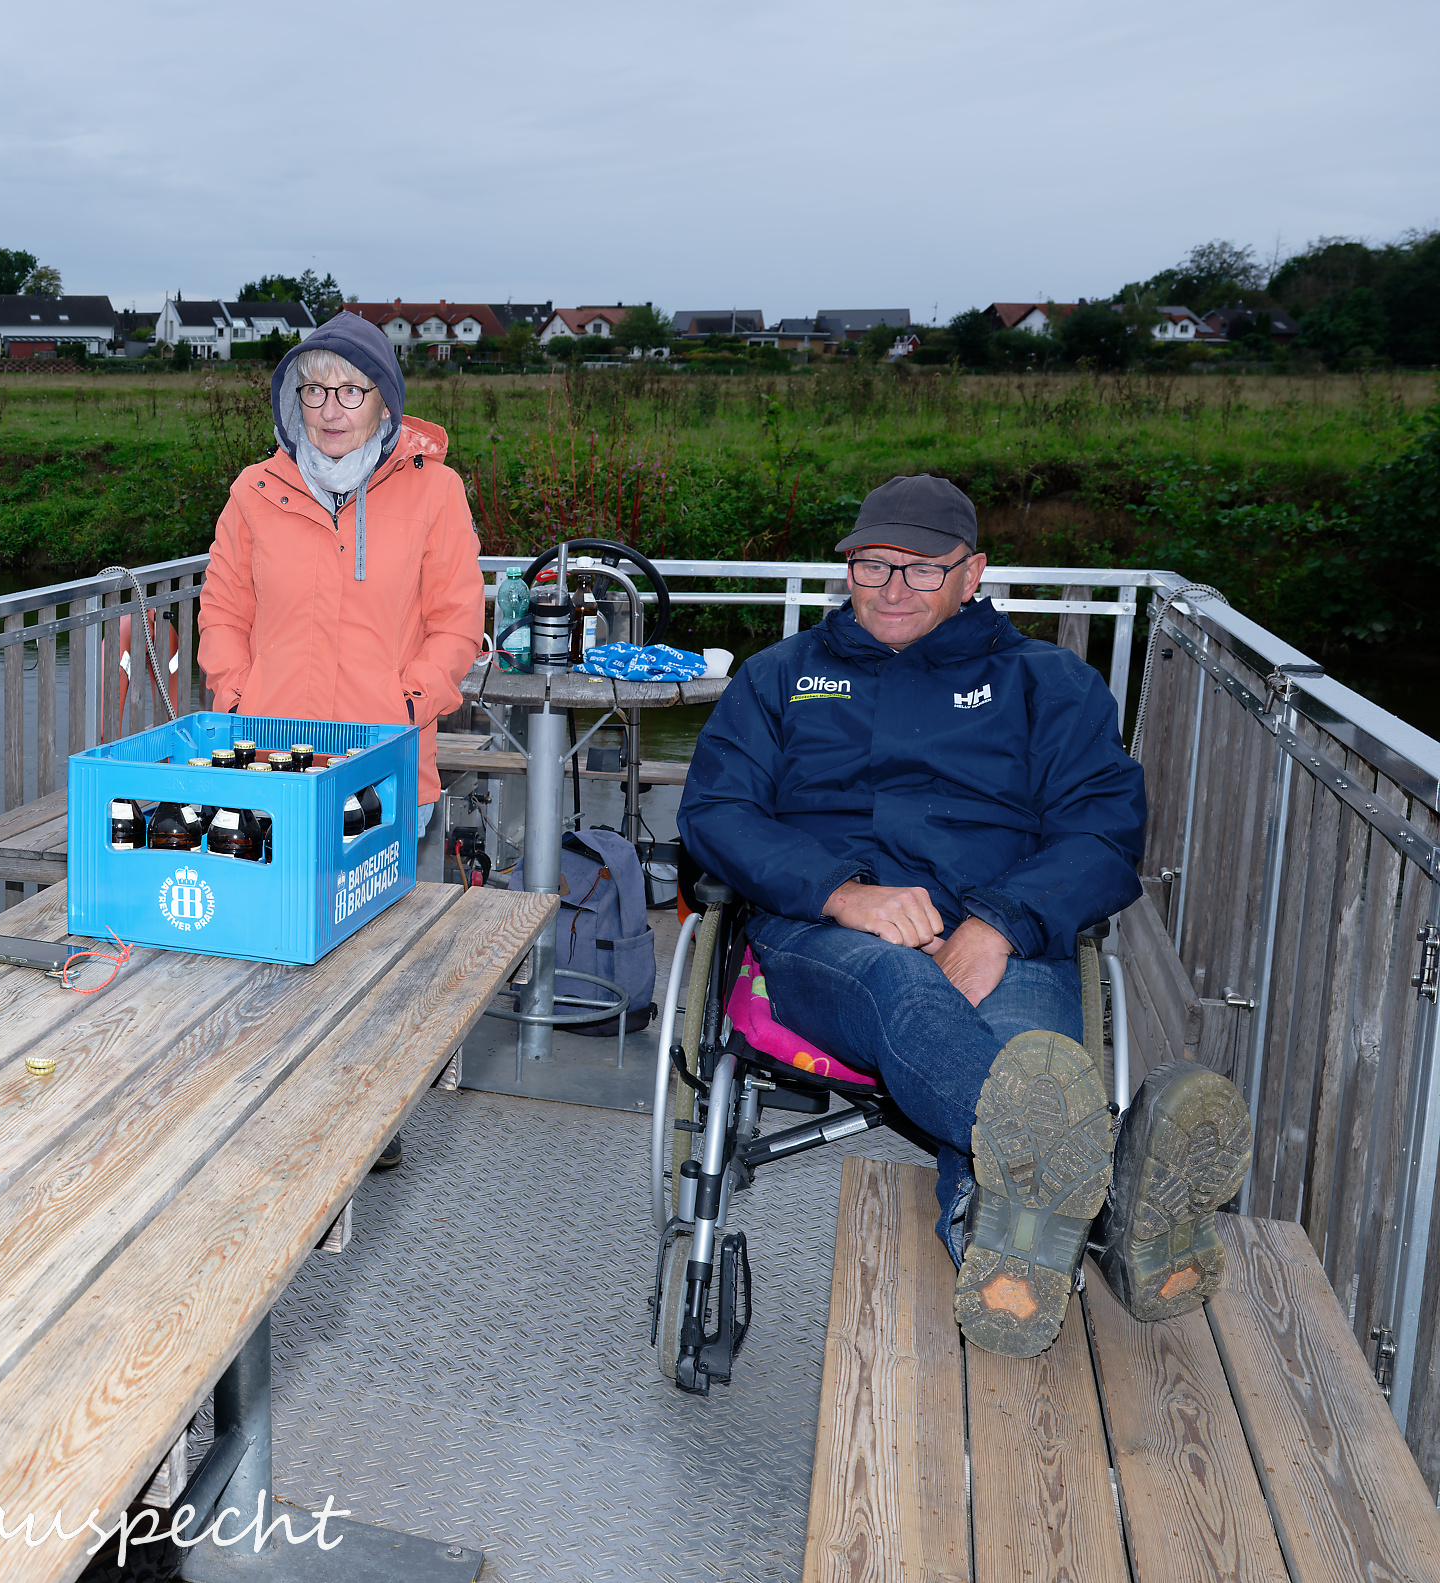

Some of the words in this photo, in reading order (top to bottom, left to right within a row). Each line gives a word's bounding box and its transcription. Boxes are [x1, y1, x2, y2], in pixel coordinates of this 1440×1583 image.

[796, 676, 851, 693] Olfen
[953, 683, 992, 706] HH
[347, 860, 399, 917] BRAUHAUS
[348, 840, 400, 892] BAYREUTHER
[158, 876, 192, 932] BAYREUTHER
[193, 879, 216, 931] BRAUHAUS
